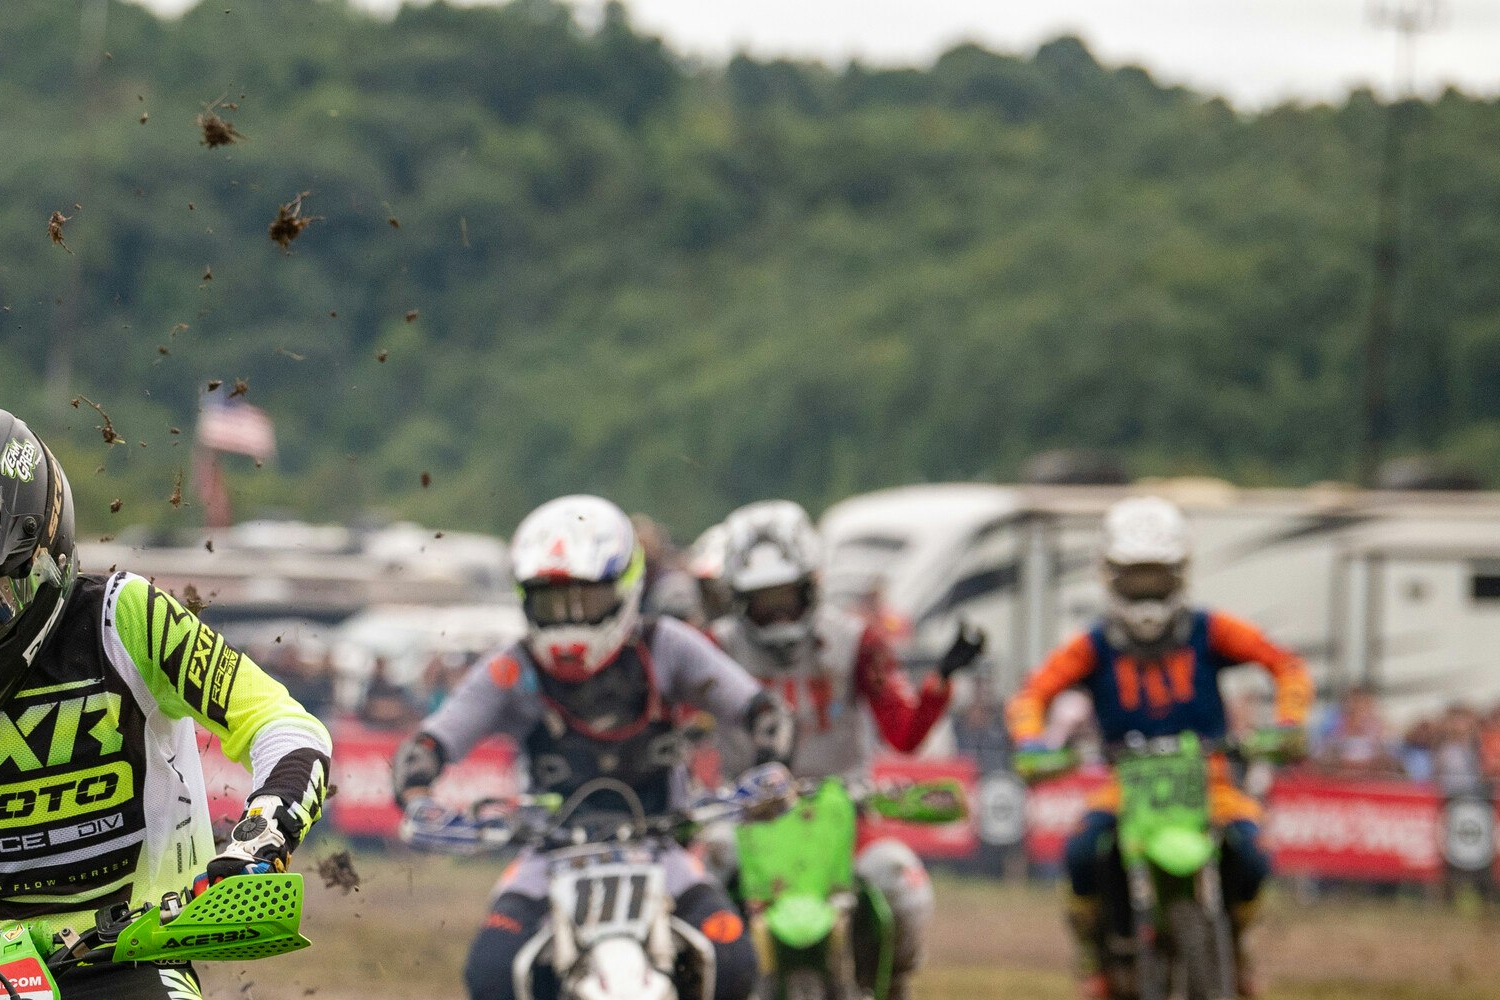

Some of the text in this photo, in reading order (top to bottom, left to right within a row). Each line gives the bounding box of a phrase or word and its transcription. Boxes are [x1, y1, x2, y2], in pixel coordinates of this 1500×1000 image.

[1, 440, 23, 477] TEAM
[16, 440, 36, 481] GREEN
[187, 623, 215, 689] FXR
[211, 645, 232, 704] RACE
[77, 815, 121, 837] DIV
[14, 879, 57, 891] FLOW
[68, 859, 130, 882] SERIES
